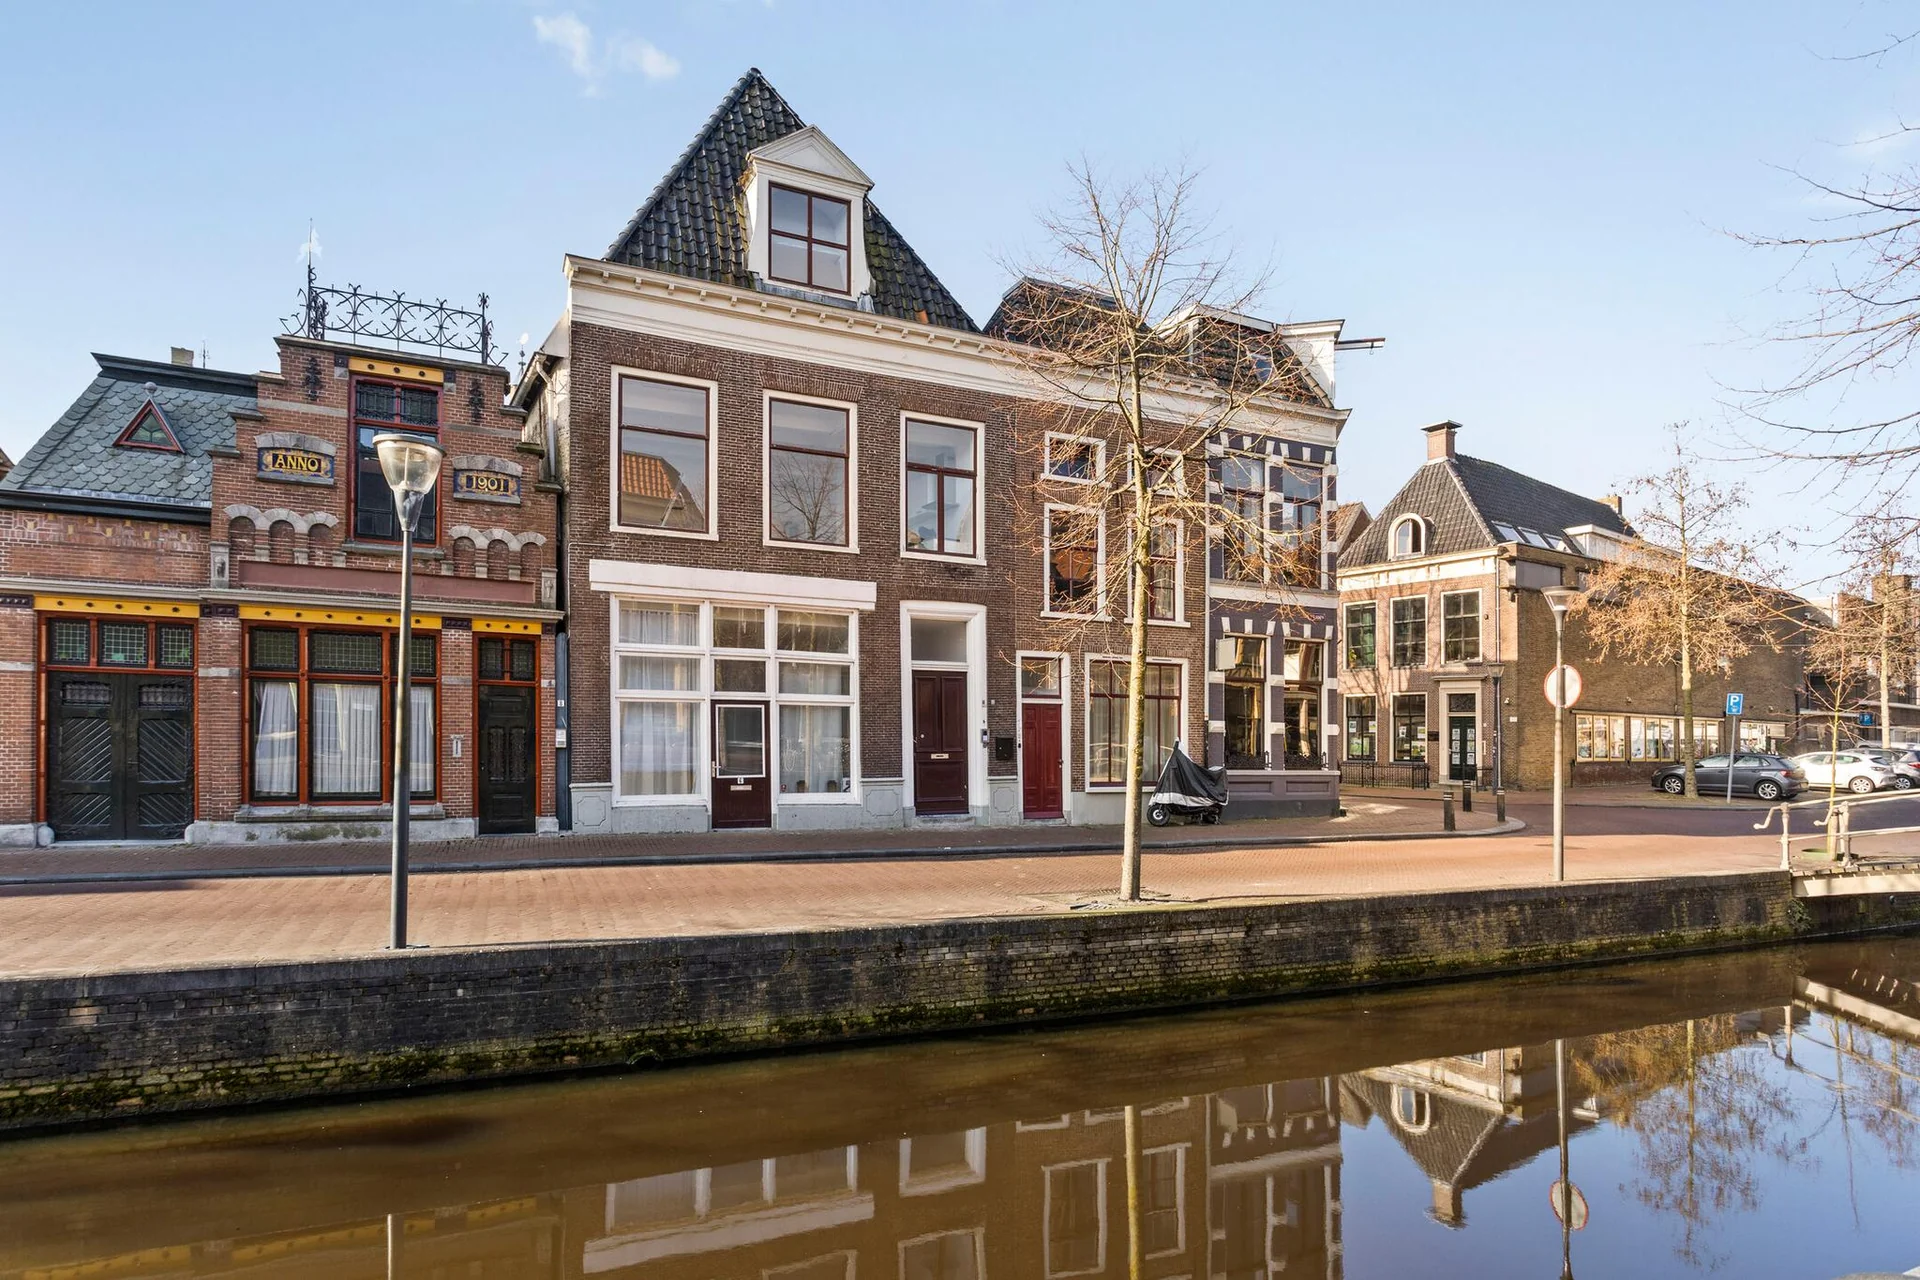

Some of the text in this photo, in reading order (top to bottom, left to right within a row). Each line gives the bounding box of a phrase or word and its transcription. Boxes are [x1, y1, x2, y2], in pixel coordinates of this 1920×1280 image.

[274, 454, 319, 472] ANNO
[472, 475, 505, 492] 1901
[1730, 695, 1740, 706] P
